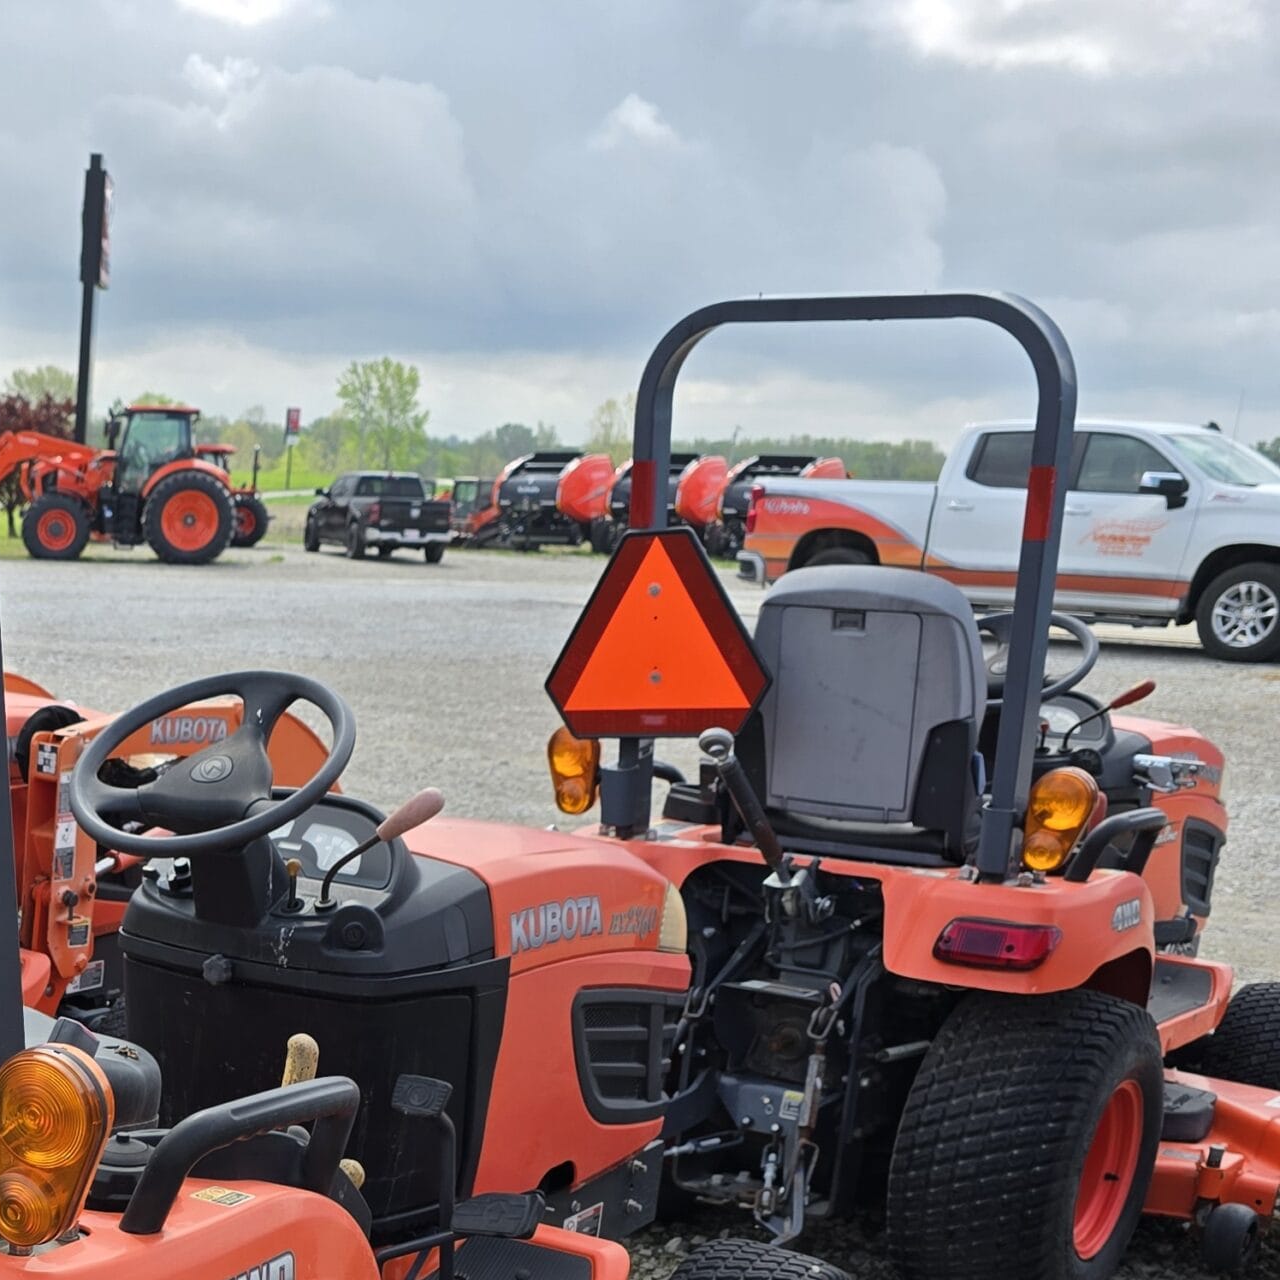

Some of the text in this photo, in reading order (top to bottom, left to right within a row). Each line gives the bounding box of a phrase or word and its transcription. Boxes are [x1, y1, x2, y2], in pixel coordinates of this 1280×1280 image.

[150, 717, 227, 744] KUBOTA
[510, 897, 602, 954] KUBOTA
[1110, 897, 1141, 933] 4WD
